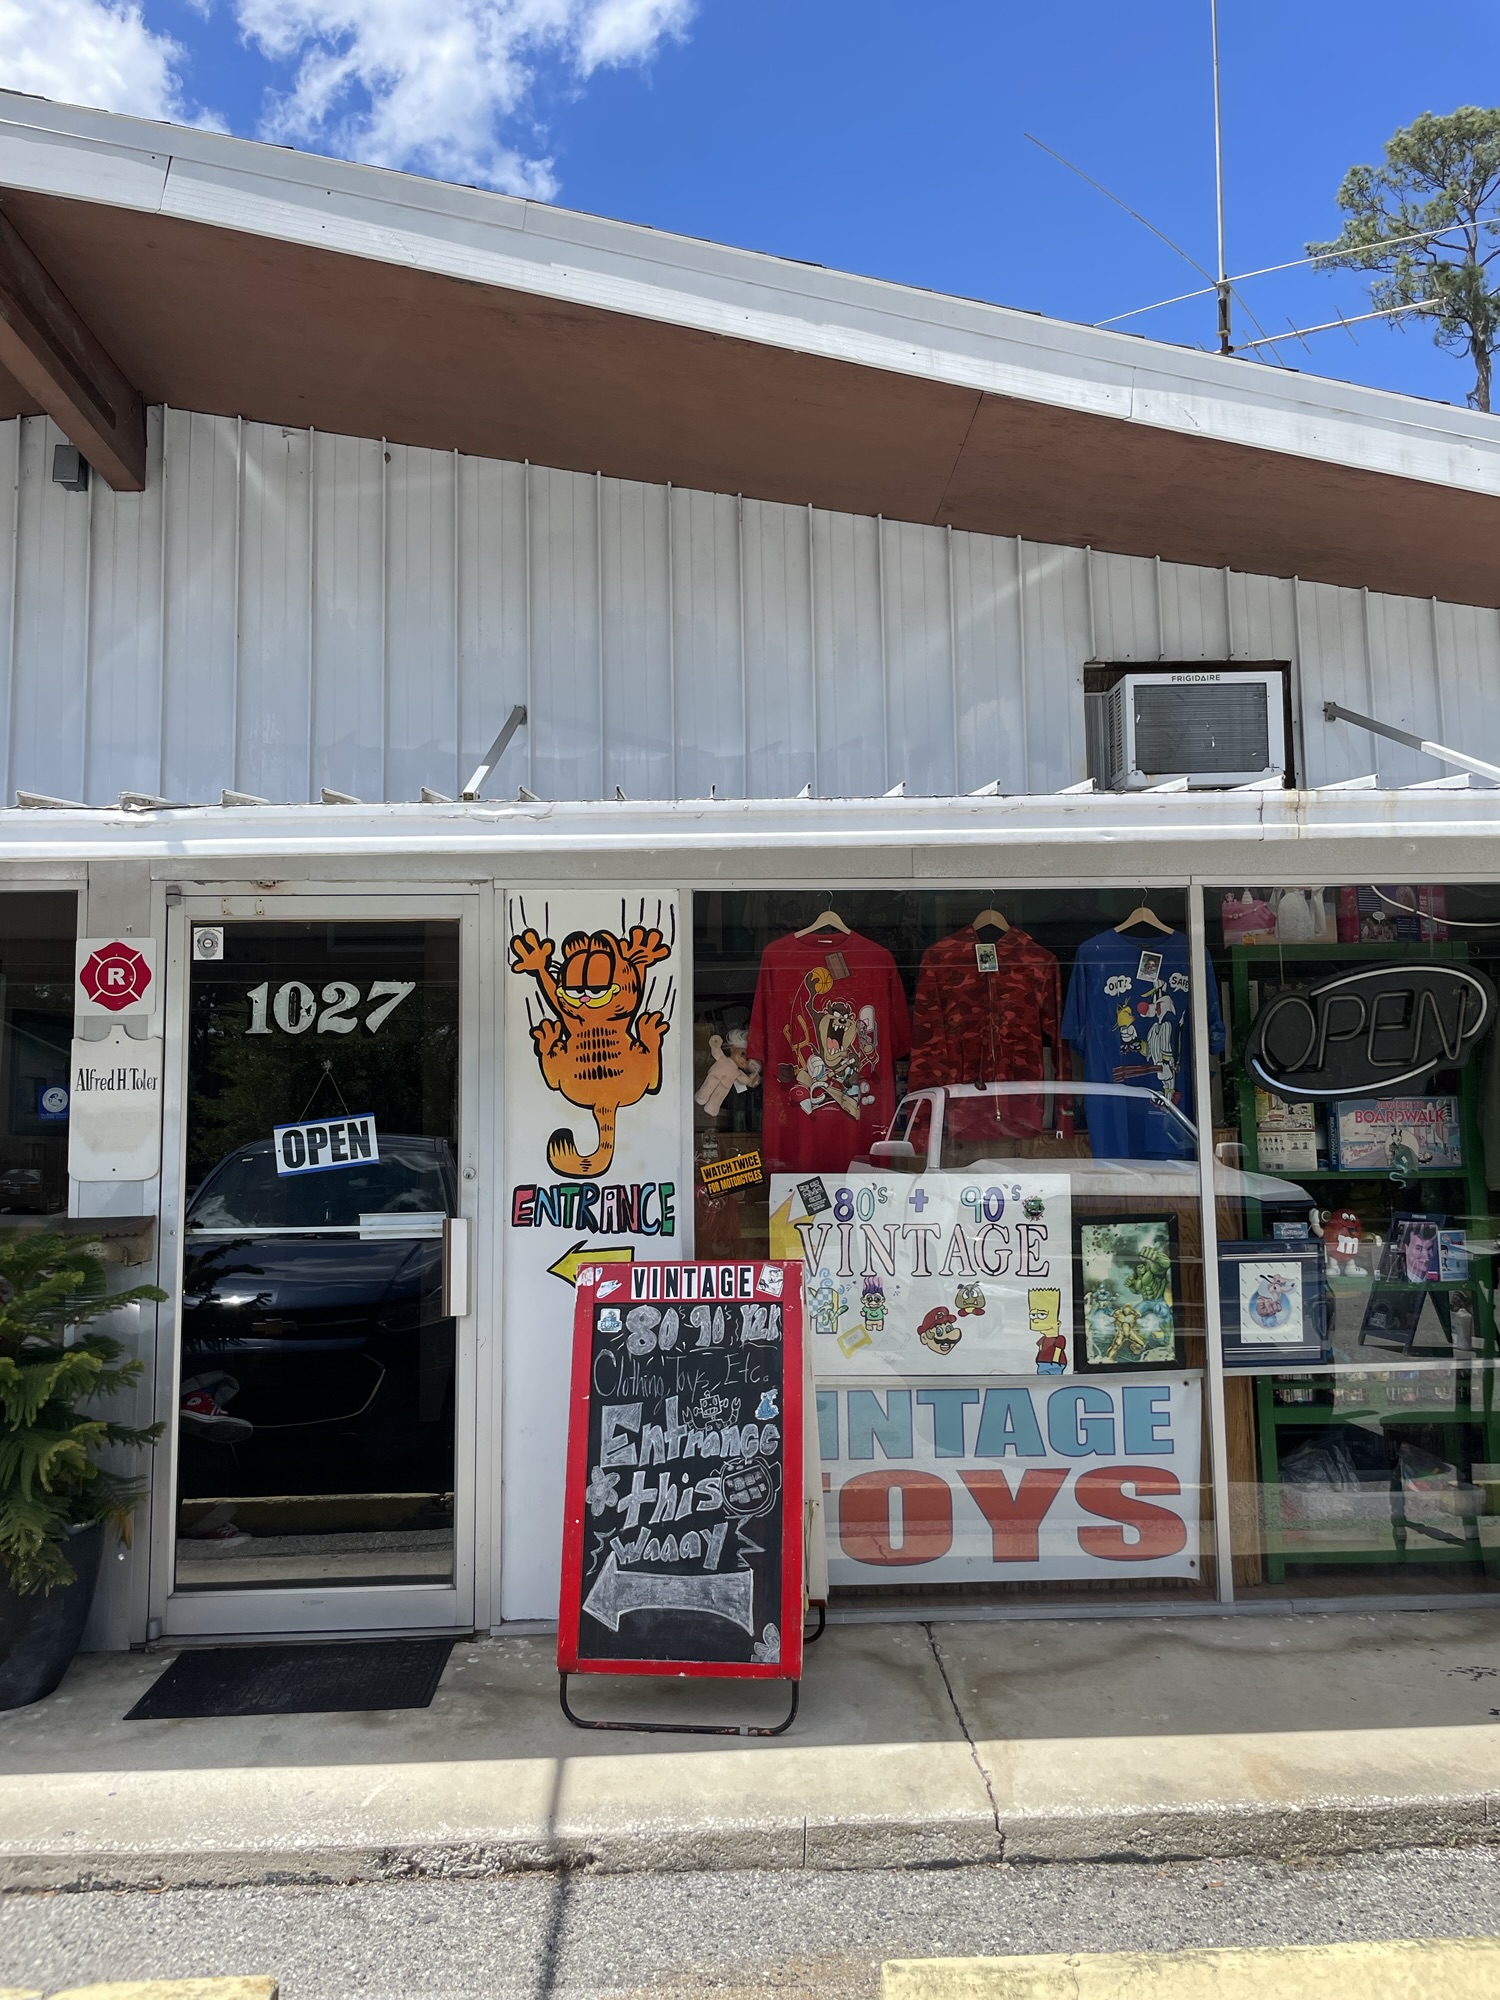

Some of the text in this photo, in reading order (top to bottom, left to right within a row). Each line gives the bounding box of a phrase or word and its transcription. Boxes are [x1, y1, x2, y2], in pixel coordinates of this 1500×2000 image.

[1171, 674, 1221, 682] FRIGIDAIRE
[107, 967, 126, 986] R
[1108, 979, 1128, 991] OUT!
[244, 980, 417, 1034] 1027
[1261, 985, 1469, 1073] OPEN
[74, 1067, 158, 1091] Alfred H. Toler
[1354, 1109, 1446, 1124] BOARDWALK
[281, 1119, 373, 1170] OPEN
[703, 1154, 760, 1179] WATCH TWICE
[707, 1169, 763, 1194] FOR MOTORCYCLES
[833, 1182, 888, 1223] 80's
[959, 1183, 1021, 1224] 90's
[511, 1182, 676, 1237] ENTRANCE
[794, 1222, 1050, 1278] VINTAGE
[633, 1267, 752, 1298] VINTAGE
[600, 1395, 781, 1468] Entrance
[815, 1385, 1175, 1461] INTAGE
[617, 1470, 723, 1531] this
[822, 1465, 1188, 1567] OYS
